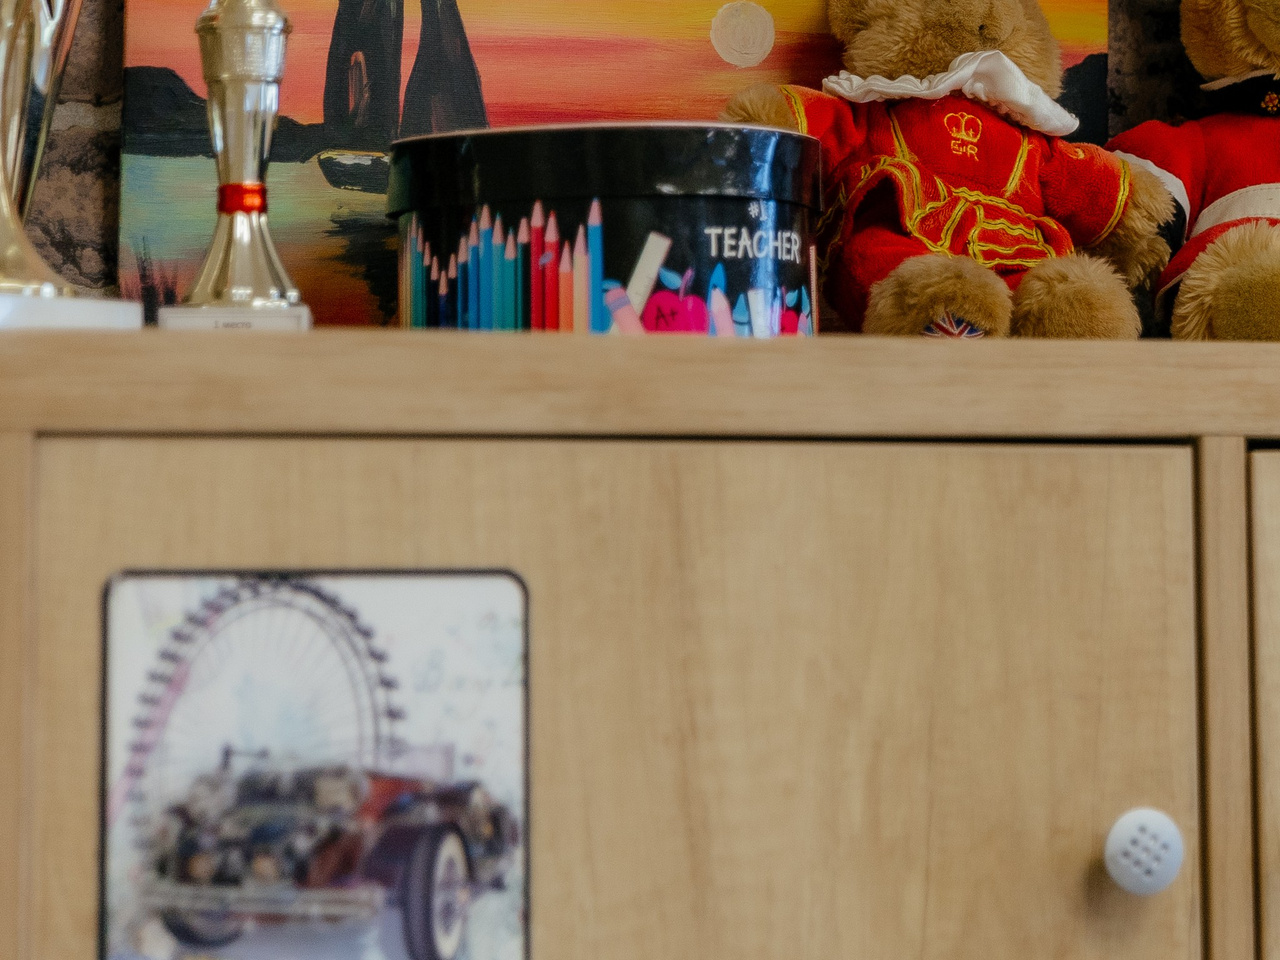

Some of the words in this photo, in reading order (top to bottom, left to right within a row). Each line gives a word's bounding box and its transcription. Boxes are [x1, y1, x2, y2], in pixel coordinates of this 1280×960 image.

[748, 199, 768, 221] #1
[704, 226, 801, 264] TEACHER
[655, 306, 678, 330] A+
